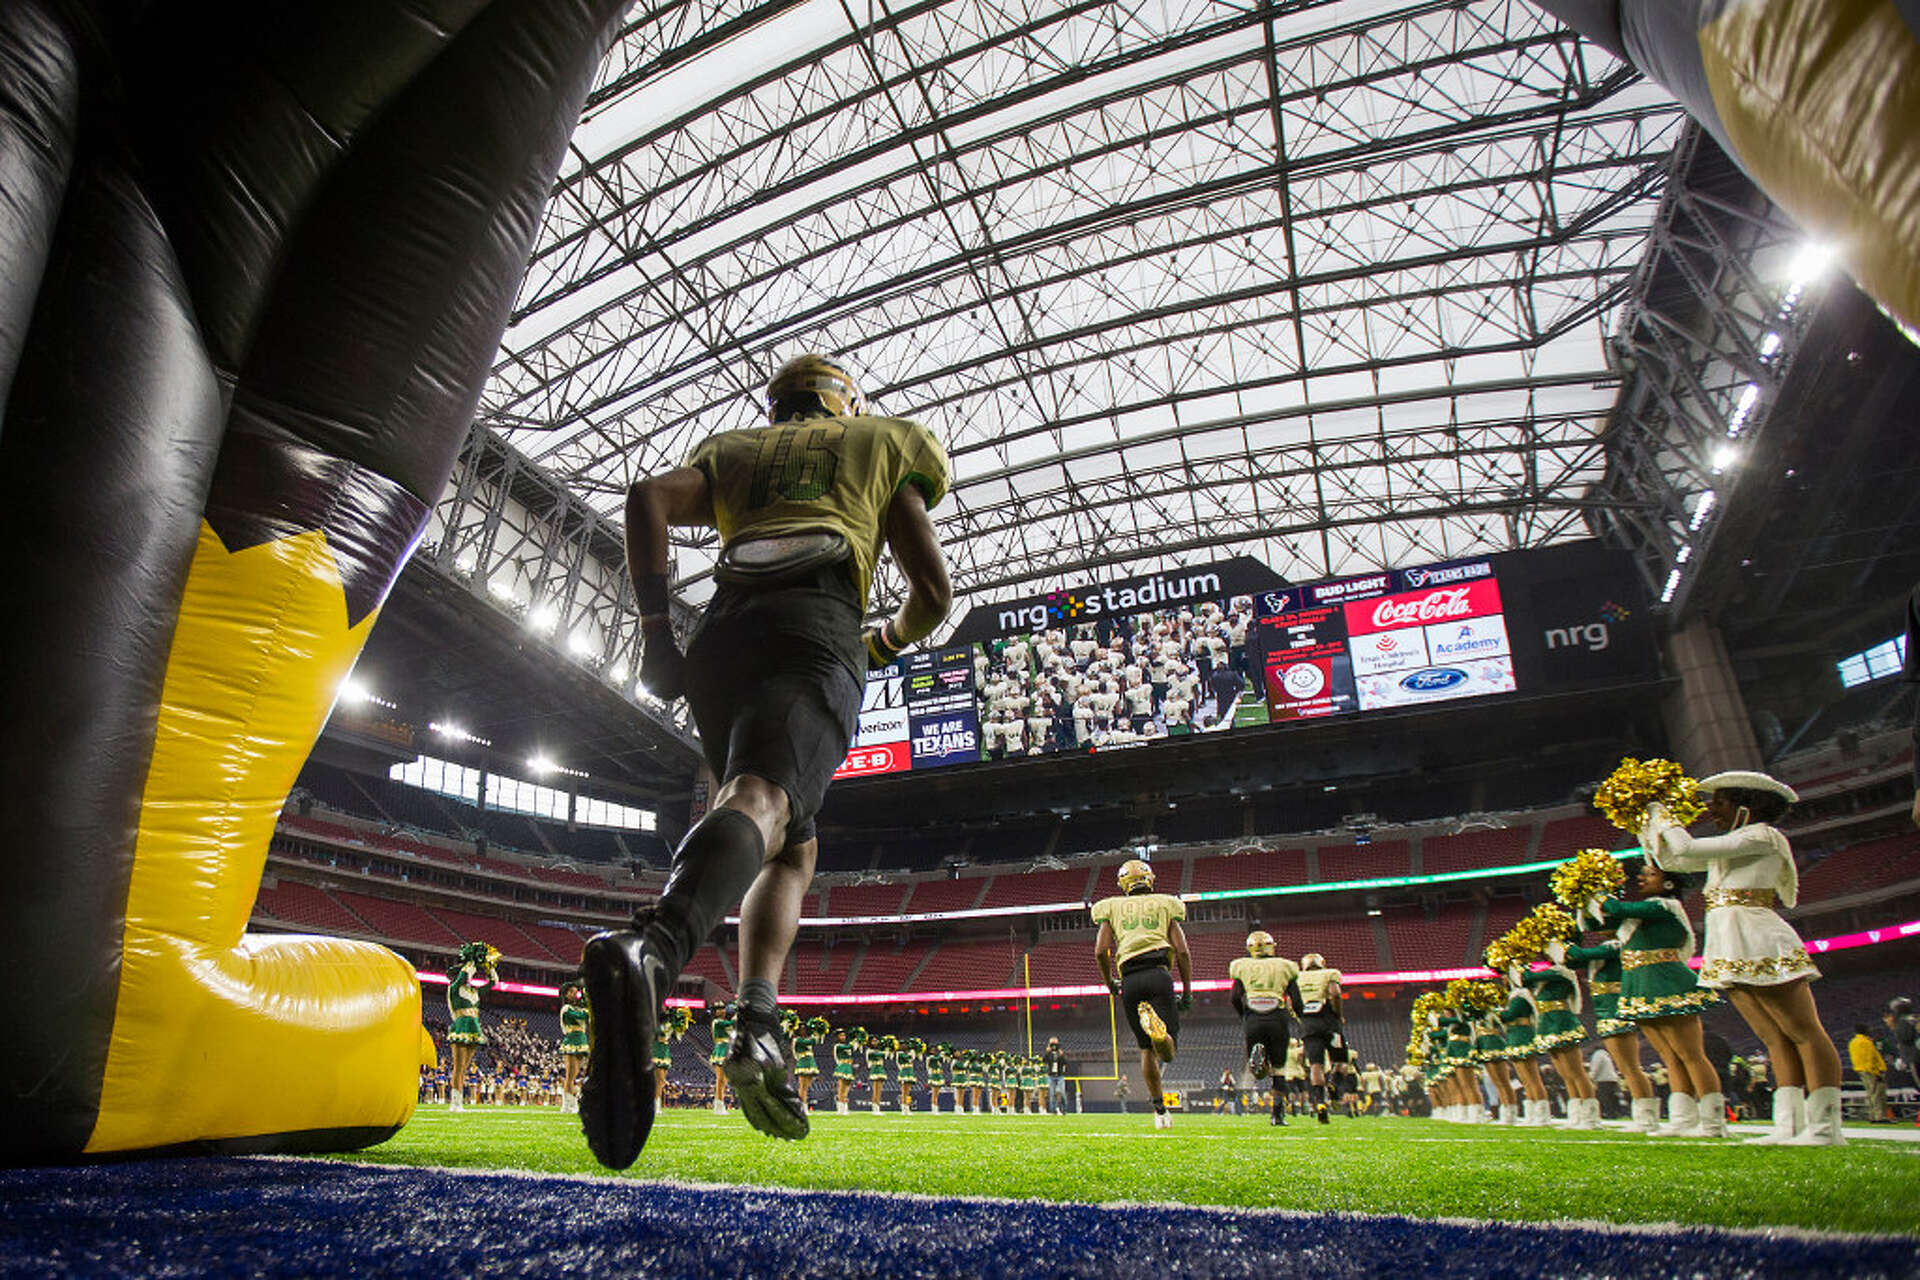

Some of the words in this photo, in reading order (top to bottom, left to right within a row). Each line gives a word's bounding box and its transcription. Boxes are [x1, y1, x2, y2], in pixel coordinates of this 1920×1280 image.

[1314, 584, 1344, 599] BUD
[1346, 576, 1387, 594] LIGHT
[999, 604, 1048, 631] nrg
[1085, 573, 1221, 614] stadium
[1372, 587, 1472, 627] Coca-Cola
[1436, 635, 1501, 655] Academy
[1545, 623, 1609, 651] nrg
[1416, 673, 1451, 688] Ford
[860, 720, 904, 734] verizon
[922, 722, 940, 735] WE
[941, 720, 963, 733] ARE
[913, 731, 976, 753] TEXANS
